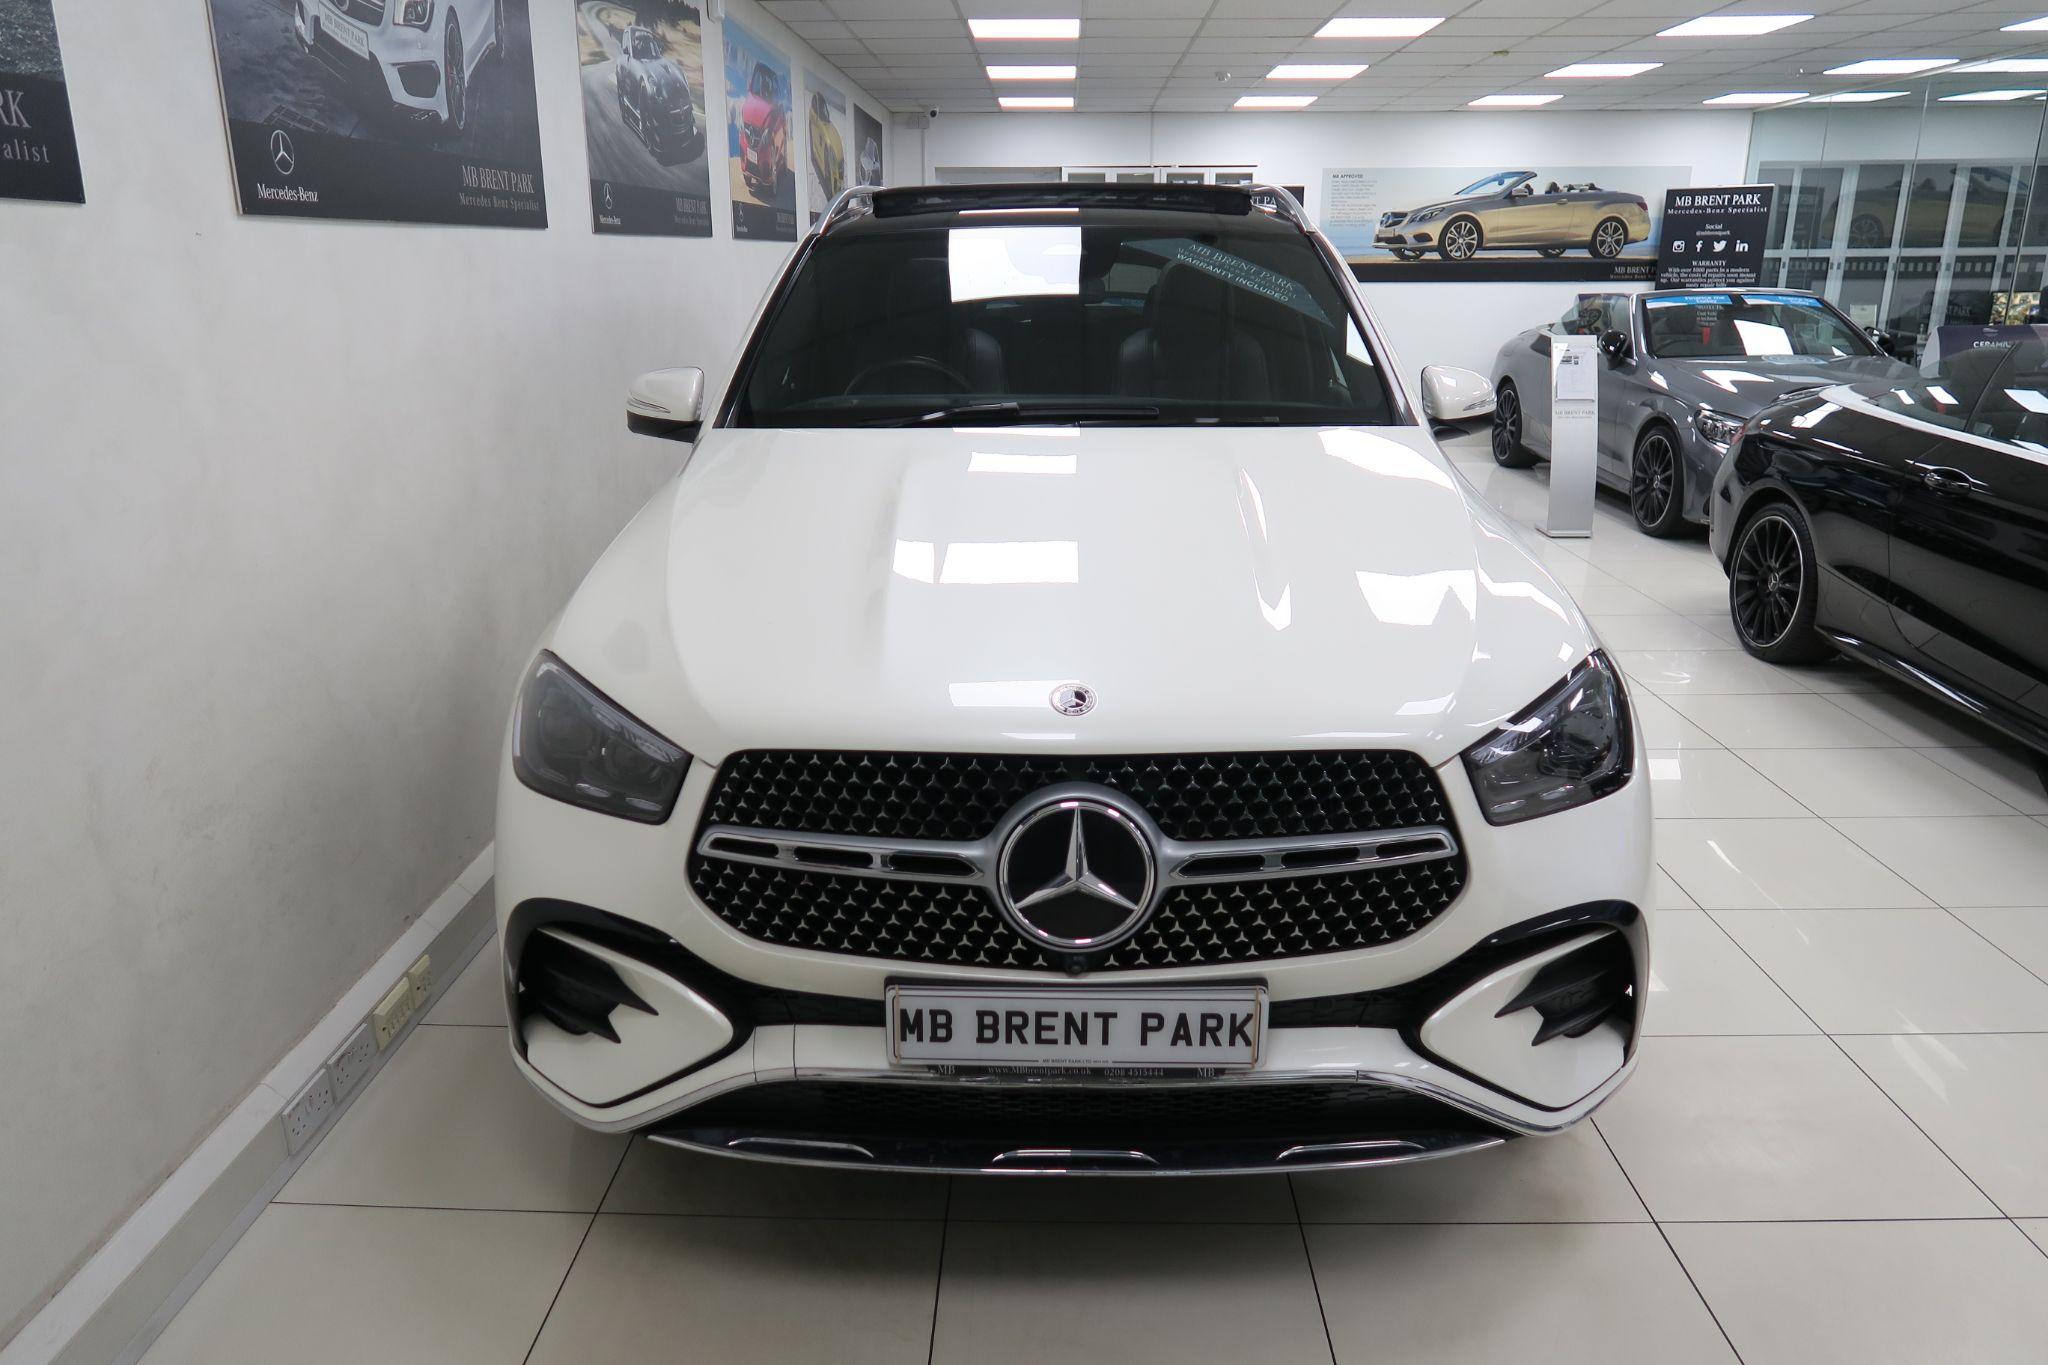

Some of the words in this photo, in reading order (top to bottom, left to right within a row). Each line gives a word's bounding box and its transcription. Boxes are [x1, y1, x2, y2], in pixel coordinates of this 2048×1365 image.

[462, 165, 479, 188] MB
[480, 167, 509, 191] BRENT
[510, 171, 535, 194] PARK
[257, 183, 319, 202] Mercedes-Benz
[1675, 196, 1692, 207] MB
[1694, 194, 1730, 206] BRENT
[1732, 193, 1761, 206] PARK
[1667, 207, 1725, 215] Mercedes-Benz
[1728, 206, 1768, 214] Specialist
[1177, 253, 1234, 279] WARRANTY
[1235, 275, 1289, 302] INCLUDED
[1189, 244, 1211, 256] MB
[1213, 252, 1256, 273] BRENT
[1260, 271, 1296, 291] PARK
[901, 1008, 953, 1043] MB
[975, 1010, 1118, 1046] BRENT
[1140, 1012, 1254, 1047] PARK
[937, 1064, 955, 1075] MB
[1197, 1067, 1215, 1077] MB
